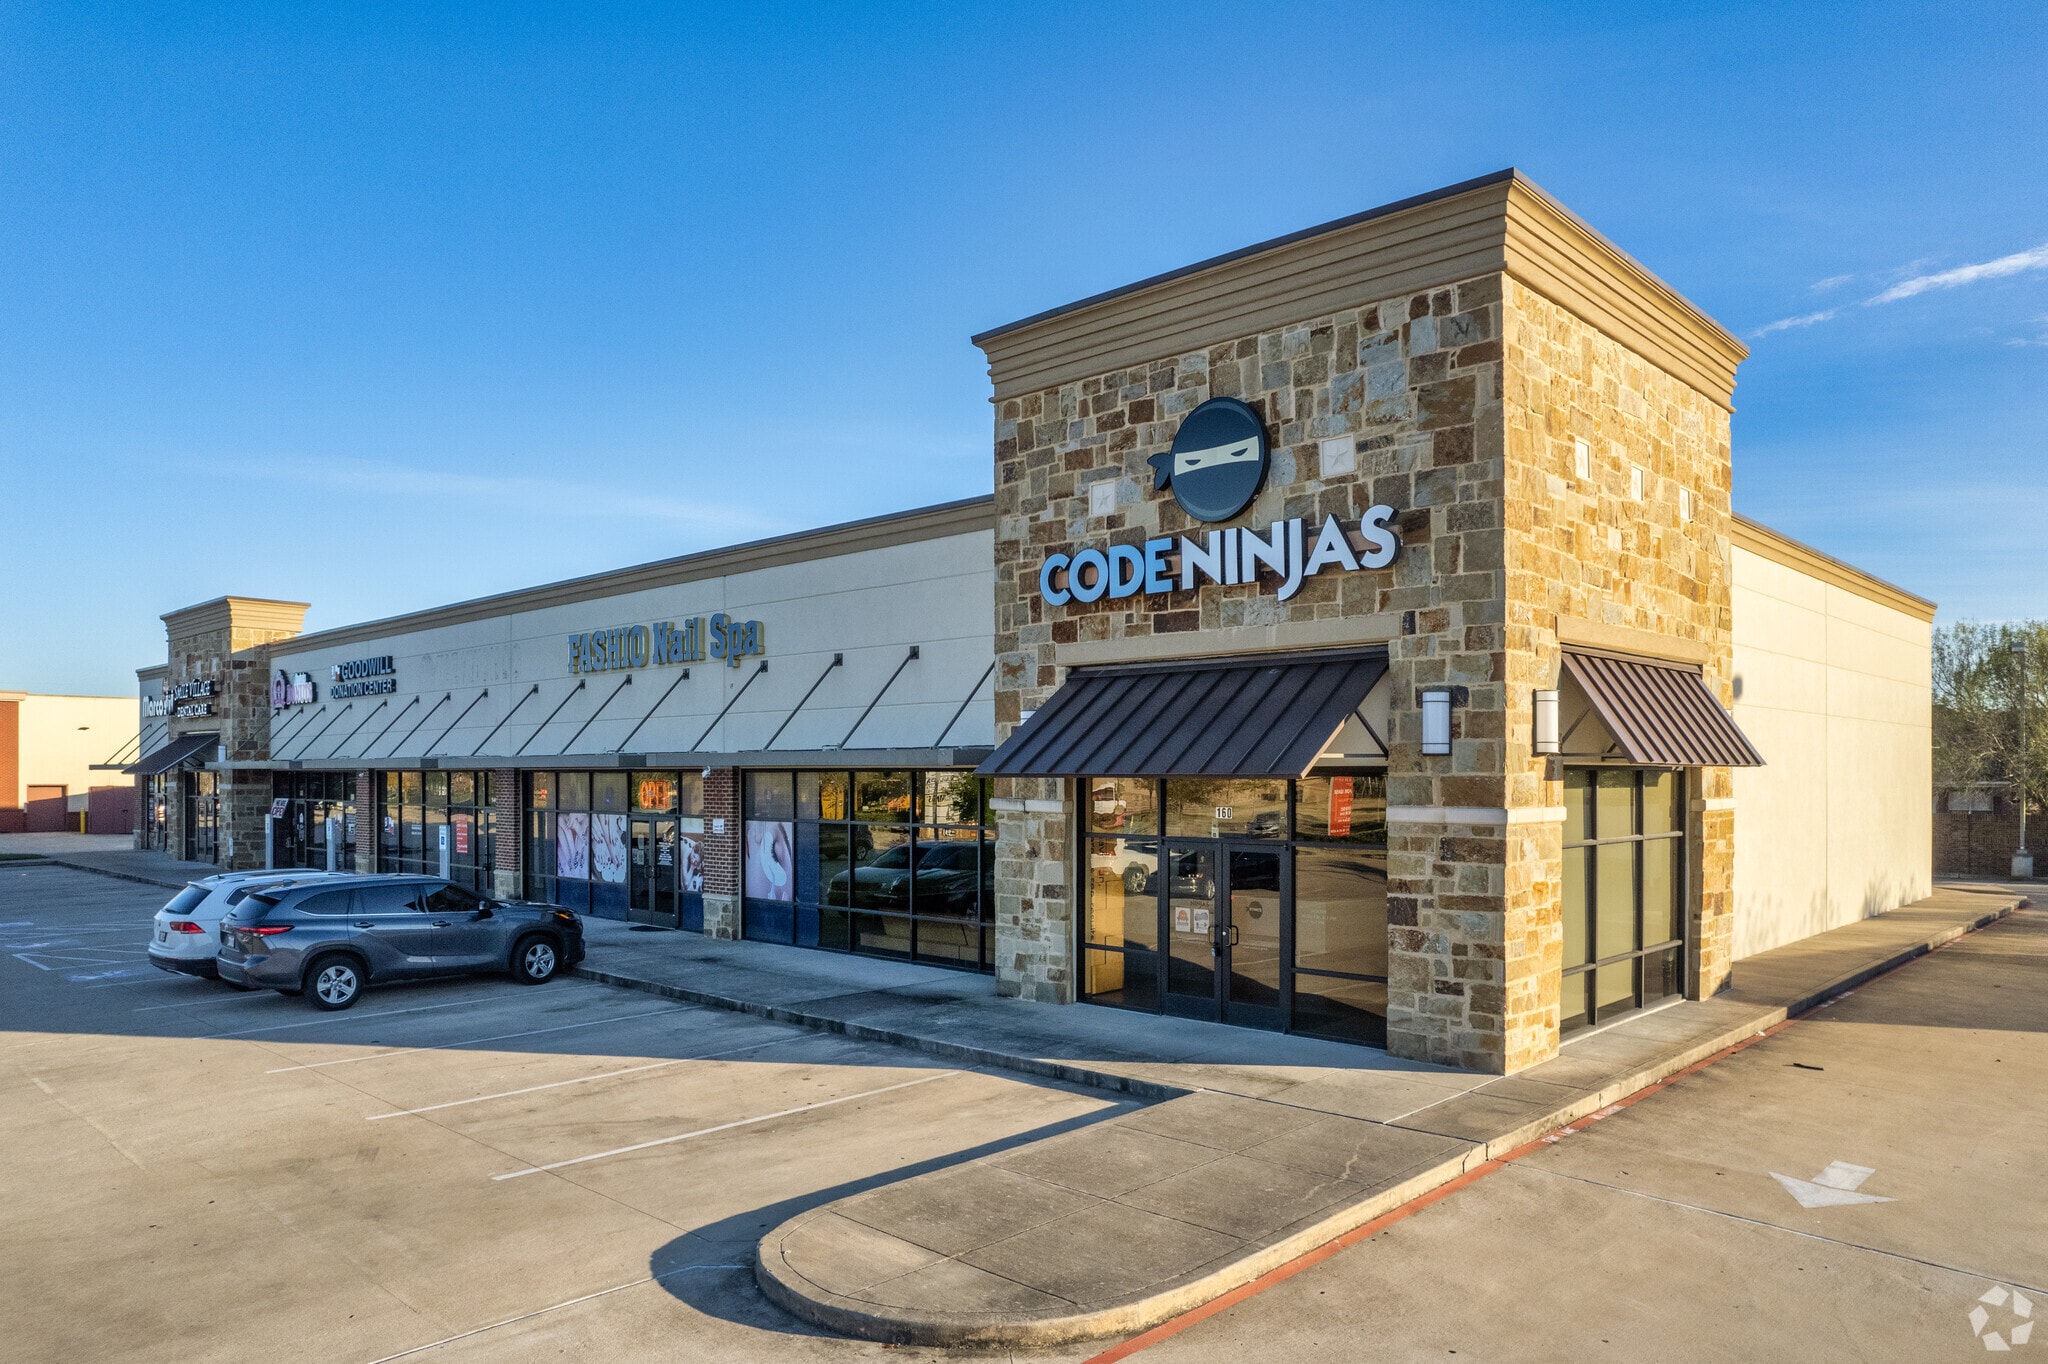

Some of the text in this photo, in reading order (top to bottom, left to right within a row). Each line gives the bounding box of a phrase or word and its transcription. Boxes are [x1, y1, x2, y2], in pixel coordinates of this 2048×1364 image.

[1039, 504, 1402, 607] CODE NINJAS
[568, 613, 765, 673] FASHIO Nail Spa
[341, 655, 393, 679] GOODWILL
[331, 678, 393, 699] DONATION CENTER
[194, 703, 208, 716] CARE
[639, 780, 672, 810] OPEN
[1216, 807, 1232, 818] 160
